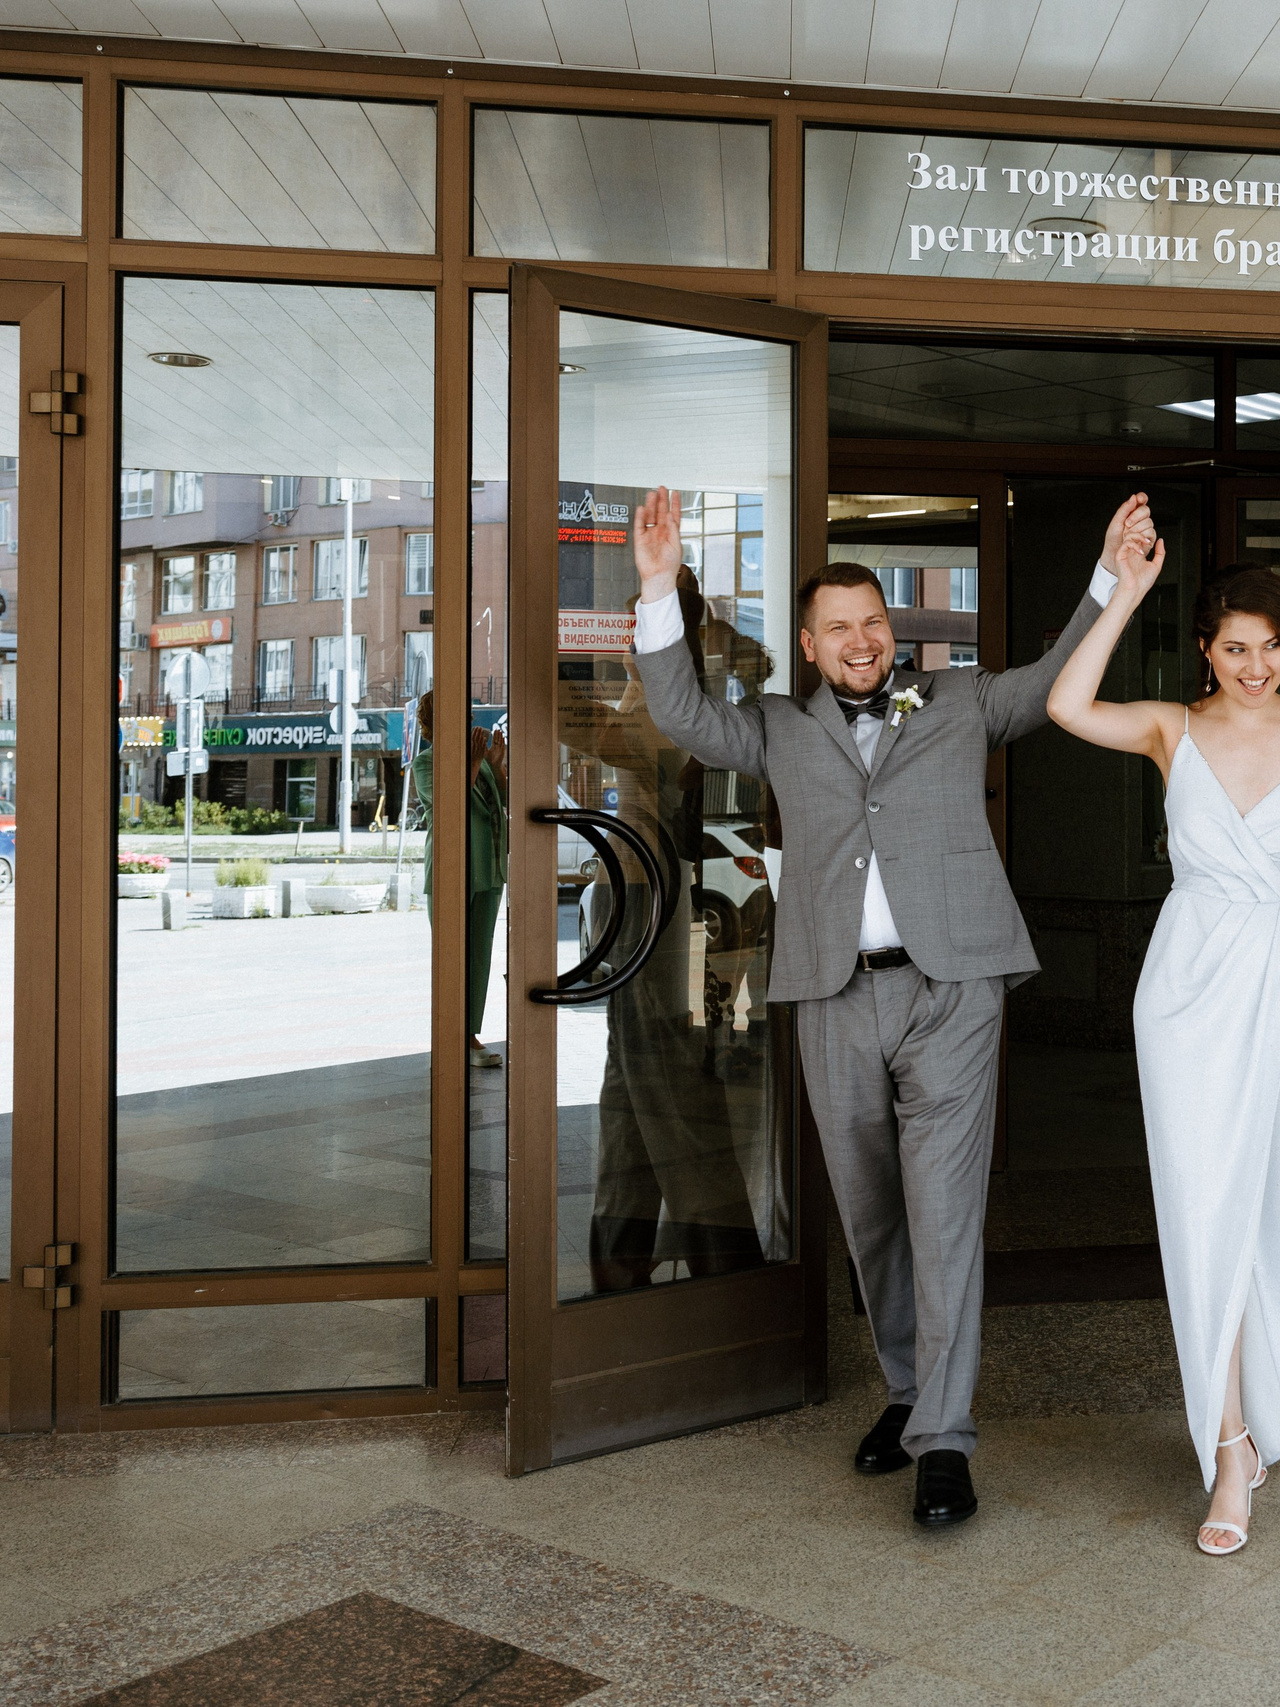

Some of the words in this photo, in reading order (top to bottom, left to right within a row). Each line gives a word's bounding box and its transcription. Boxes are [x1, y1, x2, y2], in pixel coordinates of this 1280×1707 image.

[906, 151, 988, 192] Зал
[908, 224, 1199, 268] регистрации
[557, 618, 595, 628] ОБЪЕКТ
